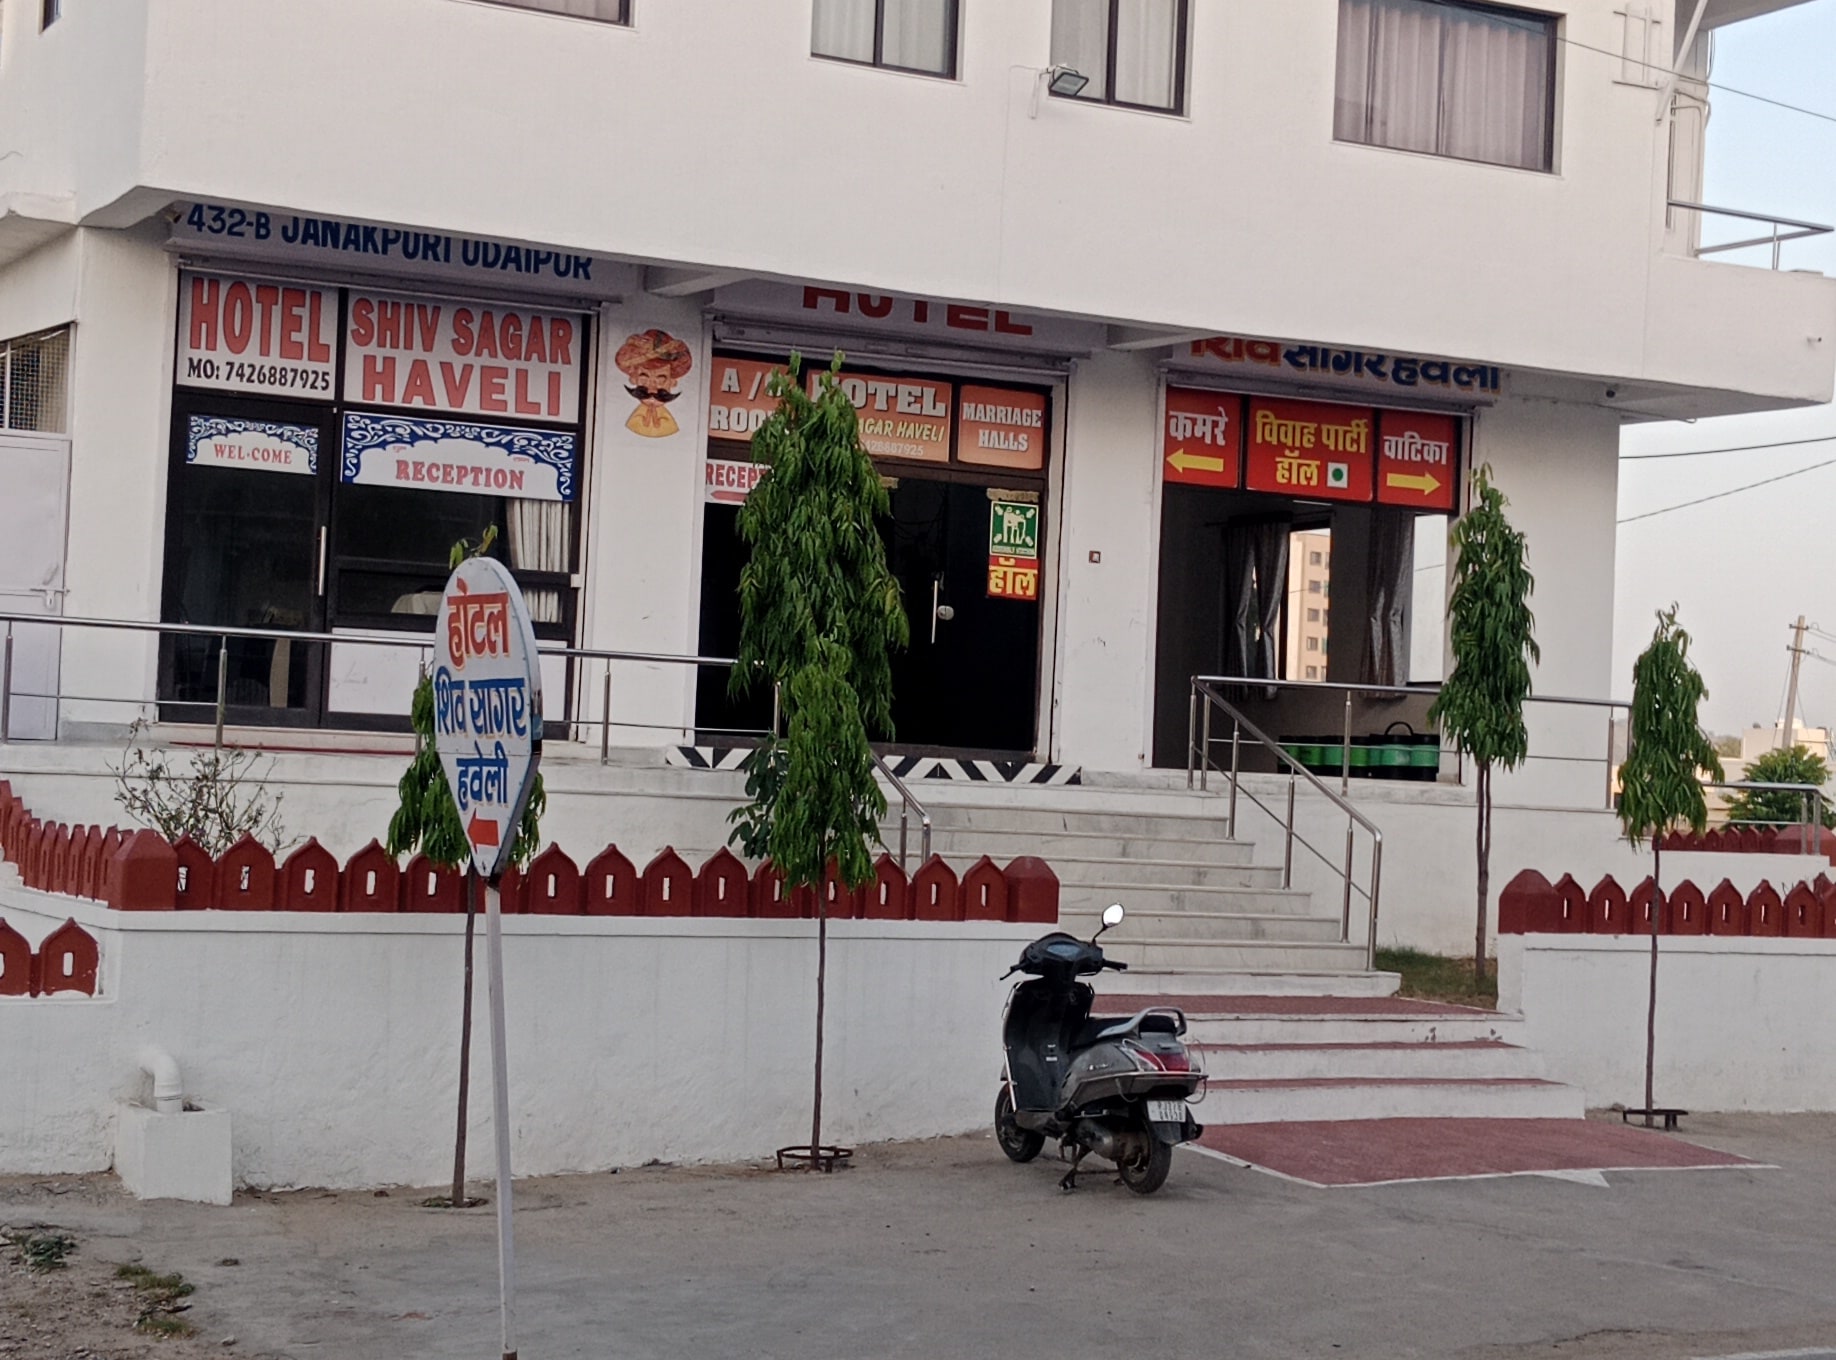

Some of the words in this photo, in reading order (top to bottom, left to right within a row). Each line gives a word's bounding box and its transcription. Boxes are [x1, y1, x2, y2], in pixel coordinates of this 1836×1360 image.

[187, 204, 271, 240] 432-B
[281, 216, 450, 263] JANAKPURI
[461, 239, 592, 281] UDAIPUR
[189, 277, 331, 363] HOTEL
[351, 297, 441, 352] SHIV
[451, 307, 573, 365] SAGAR
[187, 357, 220, 381] MO:
[225, 361, 330, 391] 7426887925
[362, 354, 561, 417] HAVELI
[710, 405, 776, 433] ROO
[896, 420, 945, 443] HAVELI
[963, 402, 1042, 428] MARRIAGE
[1169, 406, 1228, 446] कमरे
[1255, 410, 1318, 448] विवाह
[1321, 418, 1369, 453] पार्टी
[978, 429, 1029, 452] HALLS
[1383, 430, 1449, 465] वाटिका
[395, 459, 525, 491] RECEPTION
[706, 463, 767, 489] RECEP
[1275, 449, 1320, 486] हॉल
[988, 556, 1038, 596] हॉल
[447, 576, 511, 668] होटल
[435, 665, 466, 737] शिव
[468, 677, 528, 738] सागर
[456, 740, 510, 813] हवेली
